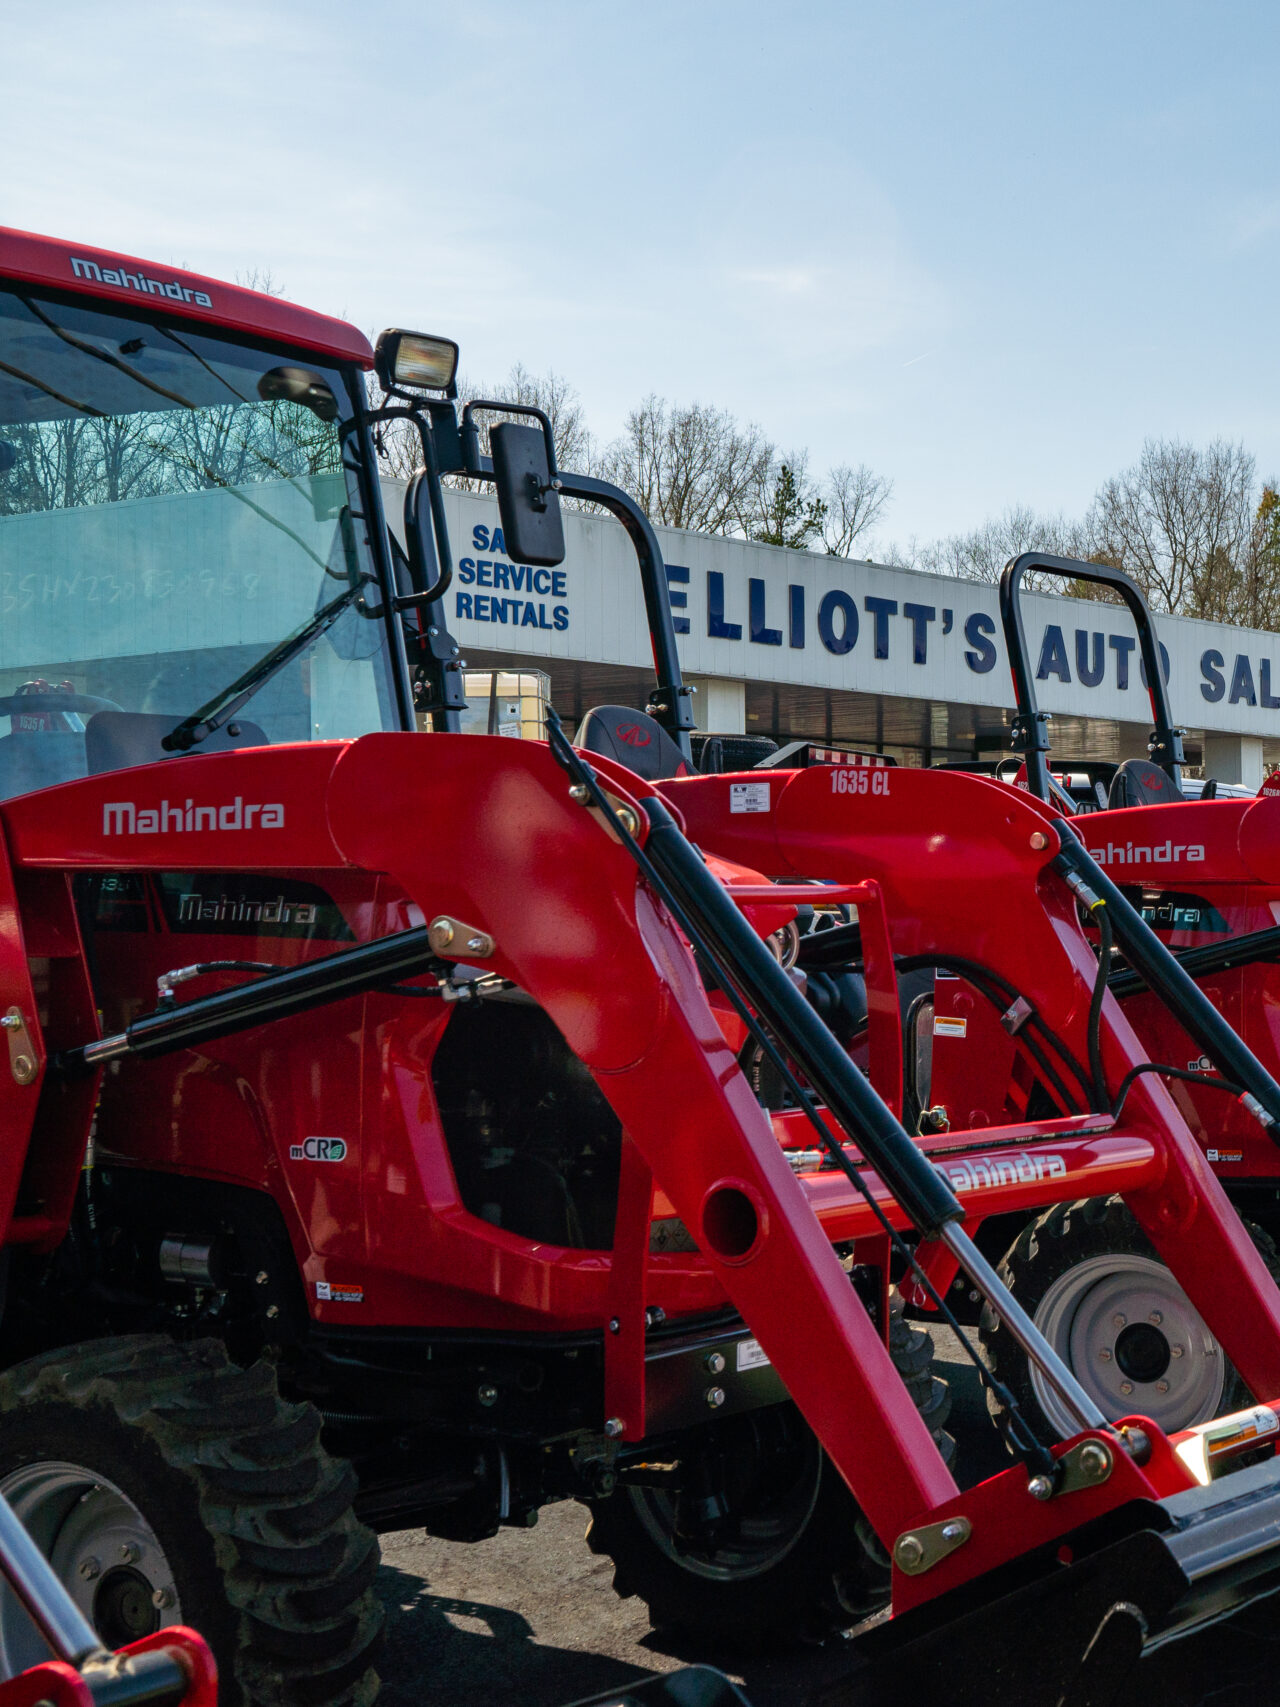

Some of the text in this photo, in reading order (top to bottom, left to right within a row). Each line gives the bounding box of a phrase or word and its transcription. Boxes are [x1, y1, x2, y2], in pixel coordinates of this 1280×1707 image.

[70, 256, 213, 308] Mahindra
[459, 557, 567, 597] SERVICE
[456, 592, 569, 631] RENTALS
[664, 564, 997, 674] ELLIOTT'S
[830, 769, 890, 796] 1635 CL
[103, 797, 284, 836] Mahindra
[1089, 840, 1205, 865] ahindra
[179, 894, 316, 924] Mahindra
